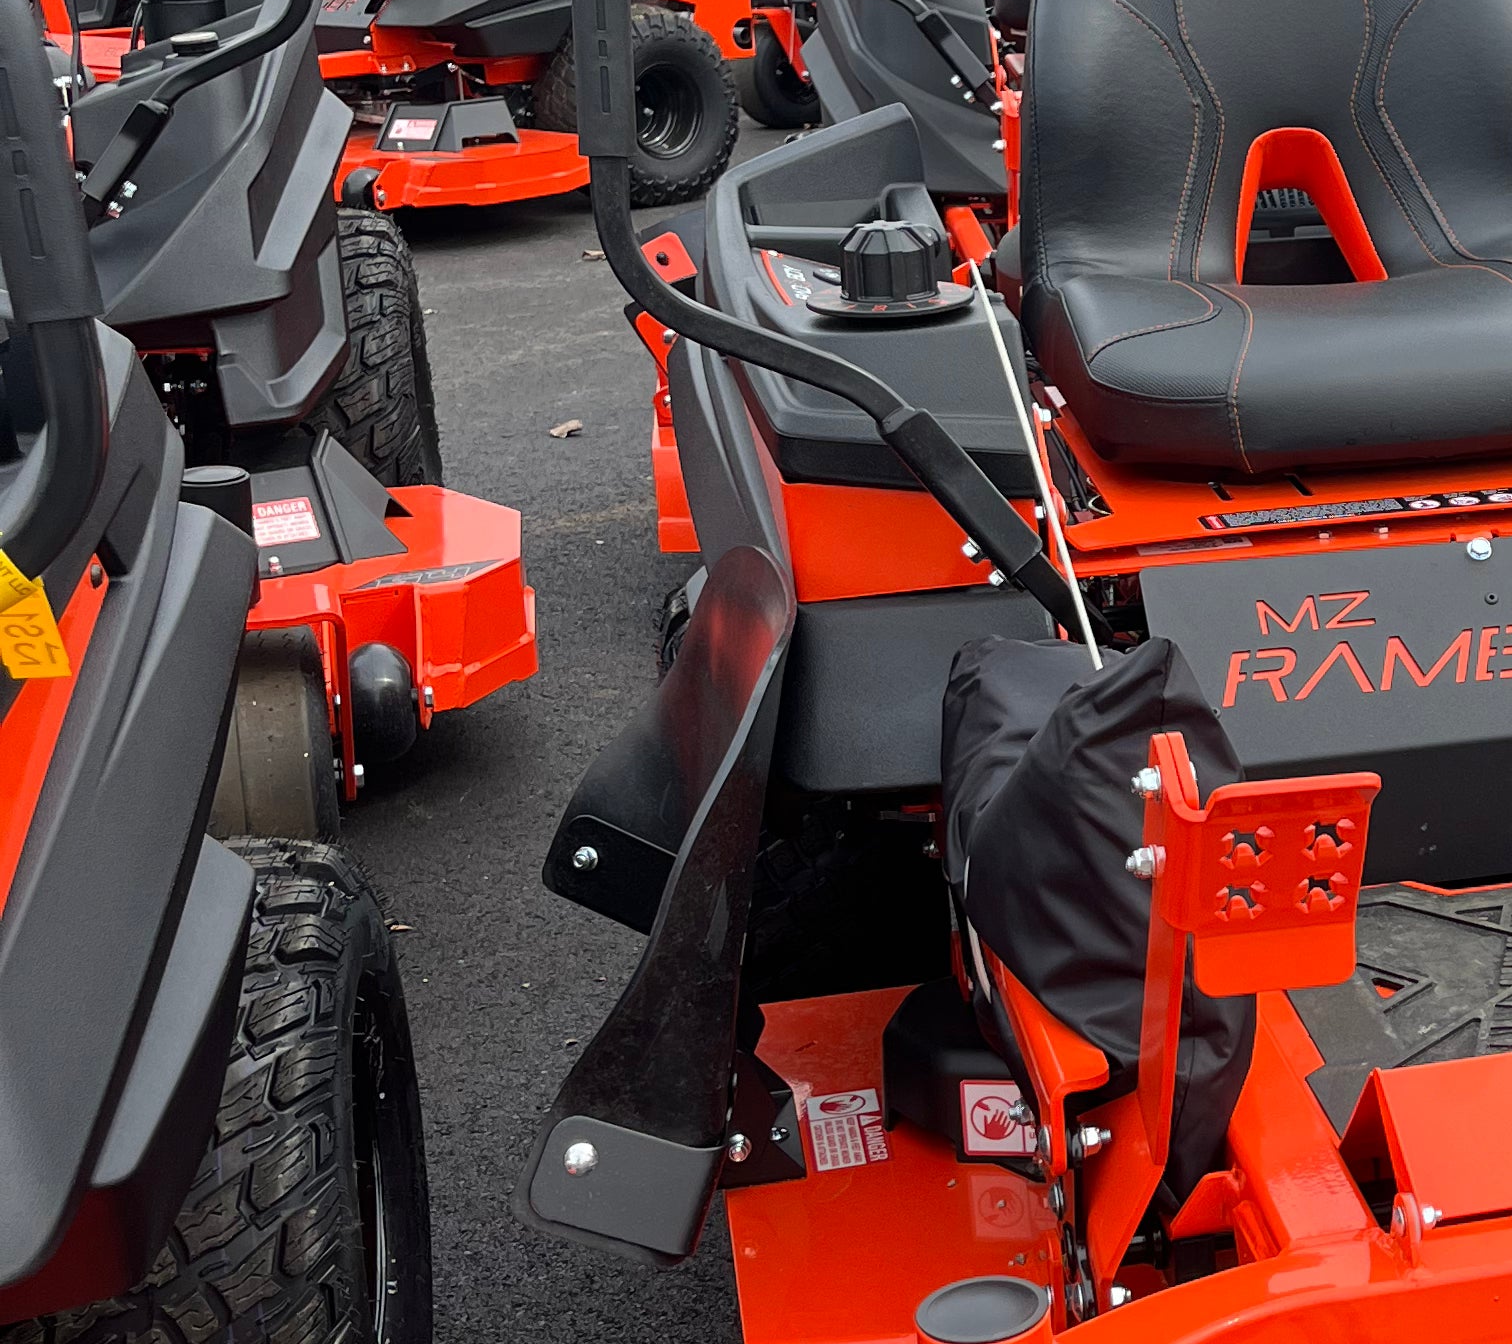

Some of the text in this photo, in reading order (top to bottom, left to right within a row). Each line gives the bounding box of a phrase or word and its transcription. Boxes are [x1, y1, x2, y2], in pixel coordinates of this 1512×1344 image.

[256, 500, 307, 516] DANGER
[1256, 591, 1376, 636] MZ
[864, 1125, 888, 1162] DANGER
